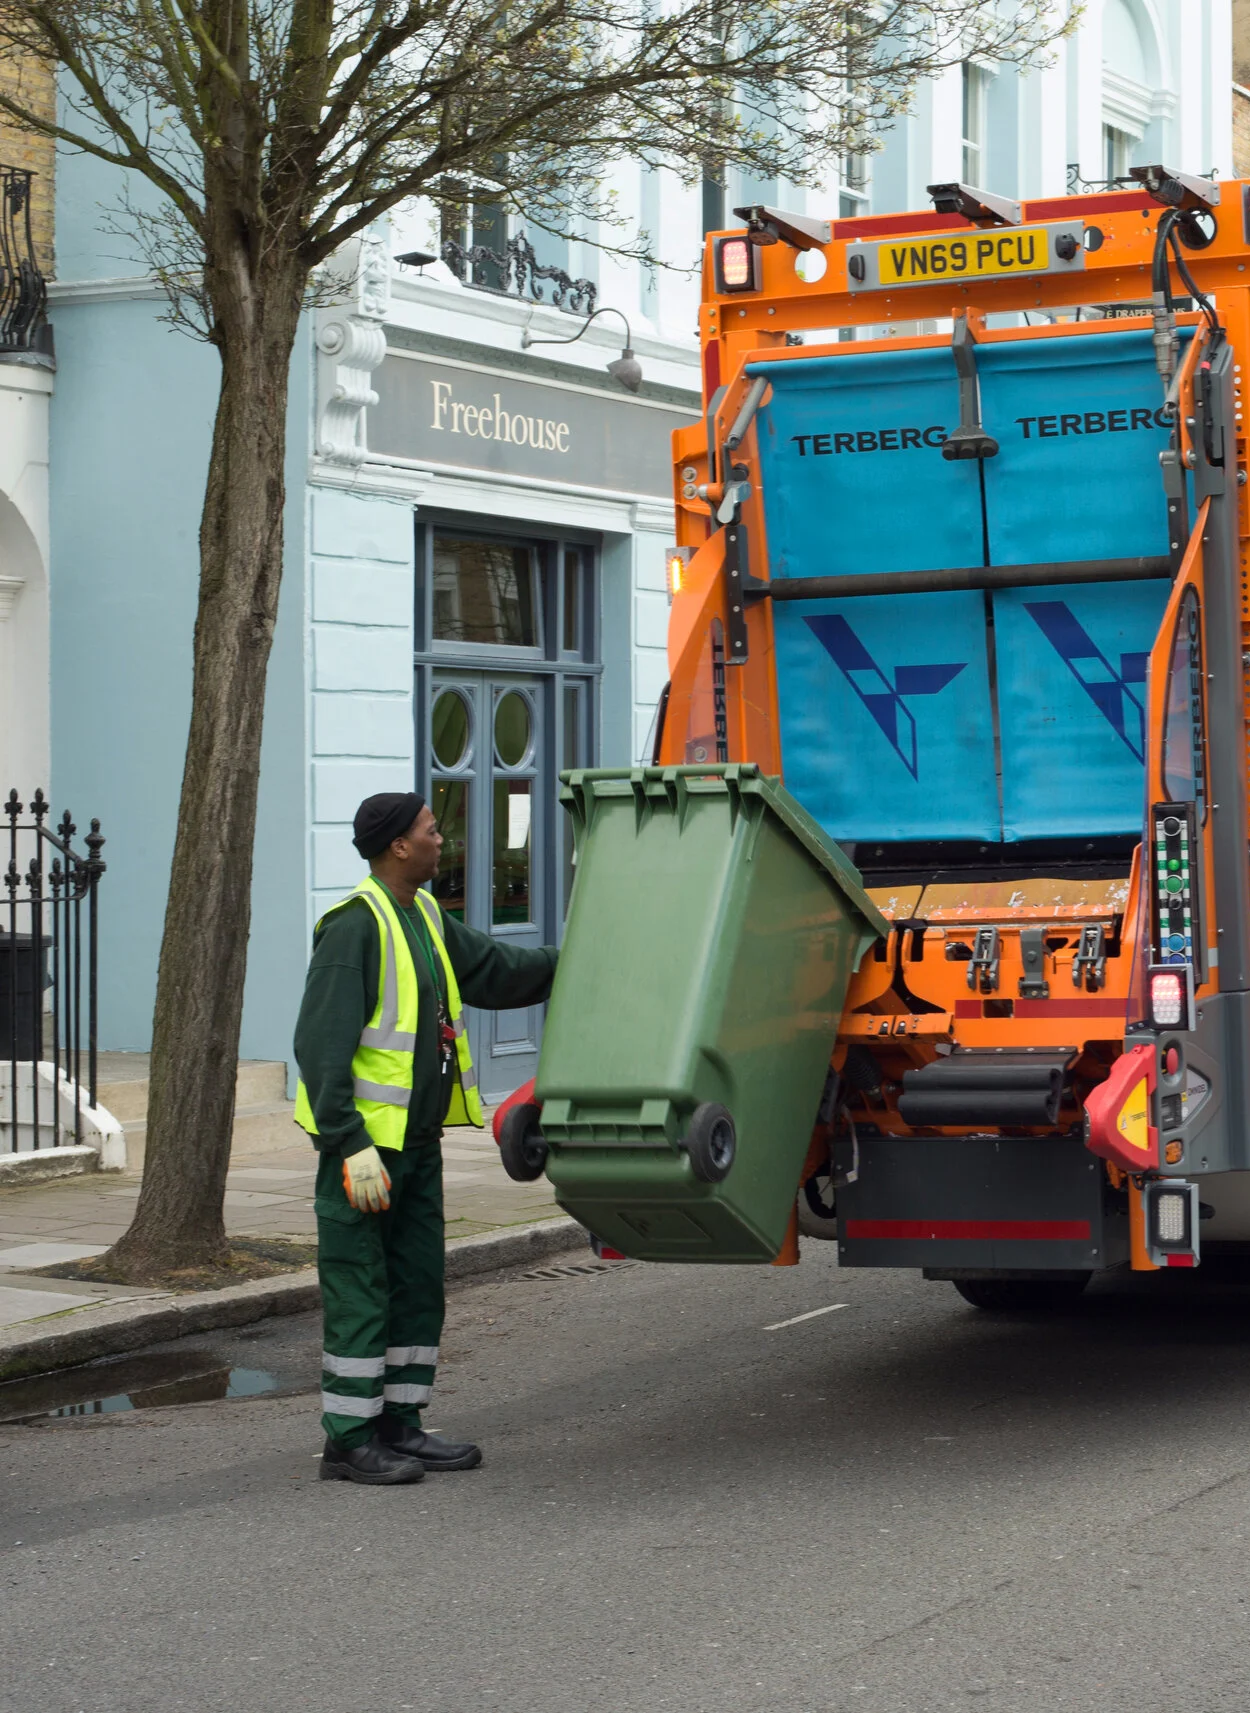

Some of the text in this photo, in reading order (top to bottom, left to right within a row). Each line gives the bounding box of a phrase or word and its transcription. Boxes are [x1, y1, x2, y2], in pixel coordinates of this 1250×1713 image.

[891, 235, 1035, 277] VN69 PCU
[1115, 308, 1153, 318] DRAPER
[429, 380, 571, 453] Freehouse
[1013, 406, 1174, 439] TERBERG
[789, 425, 948, 457] TERBERG
